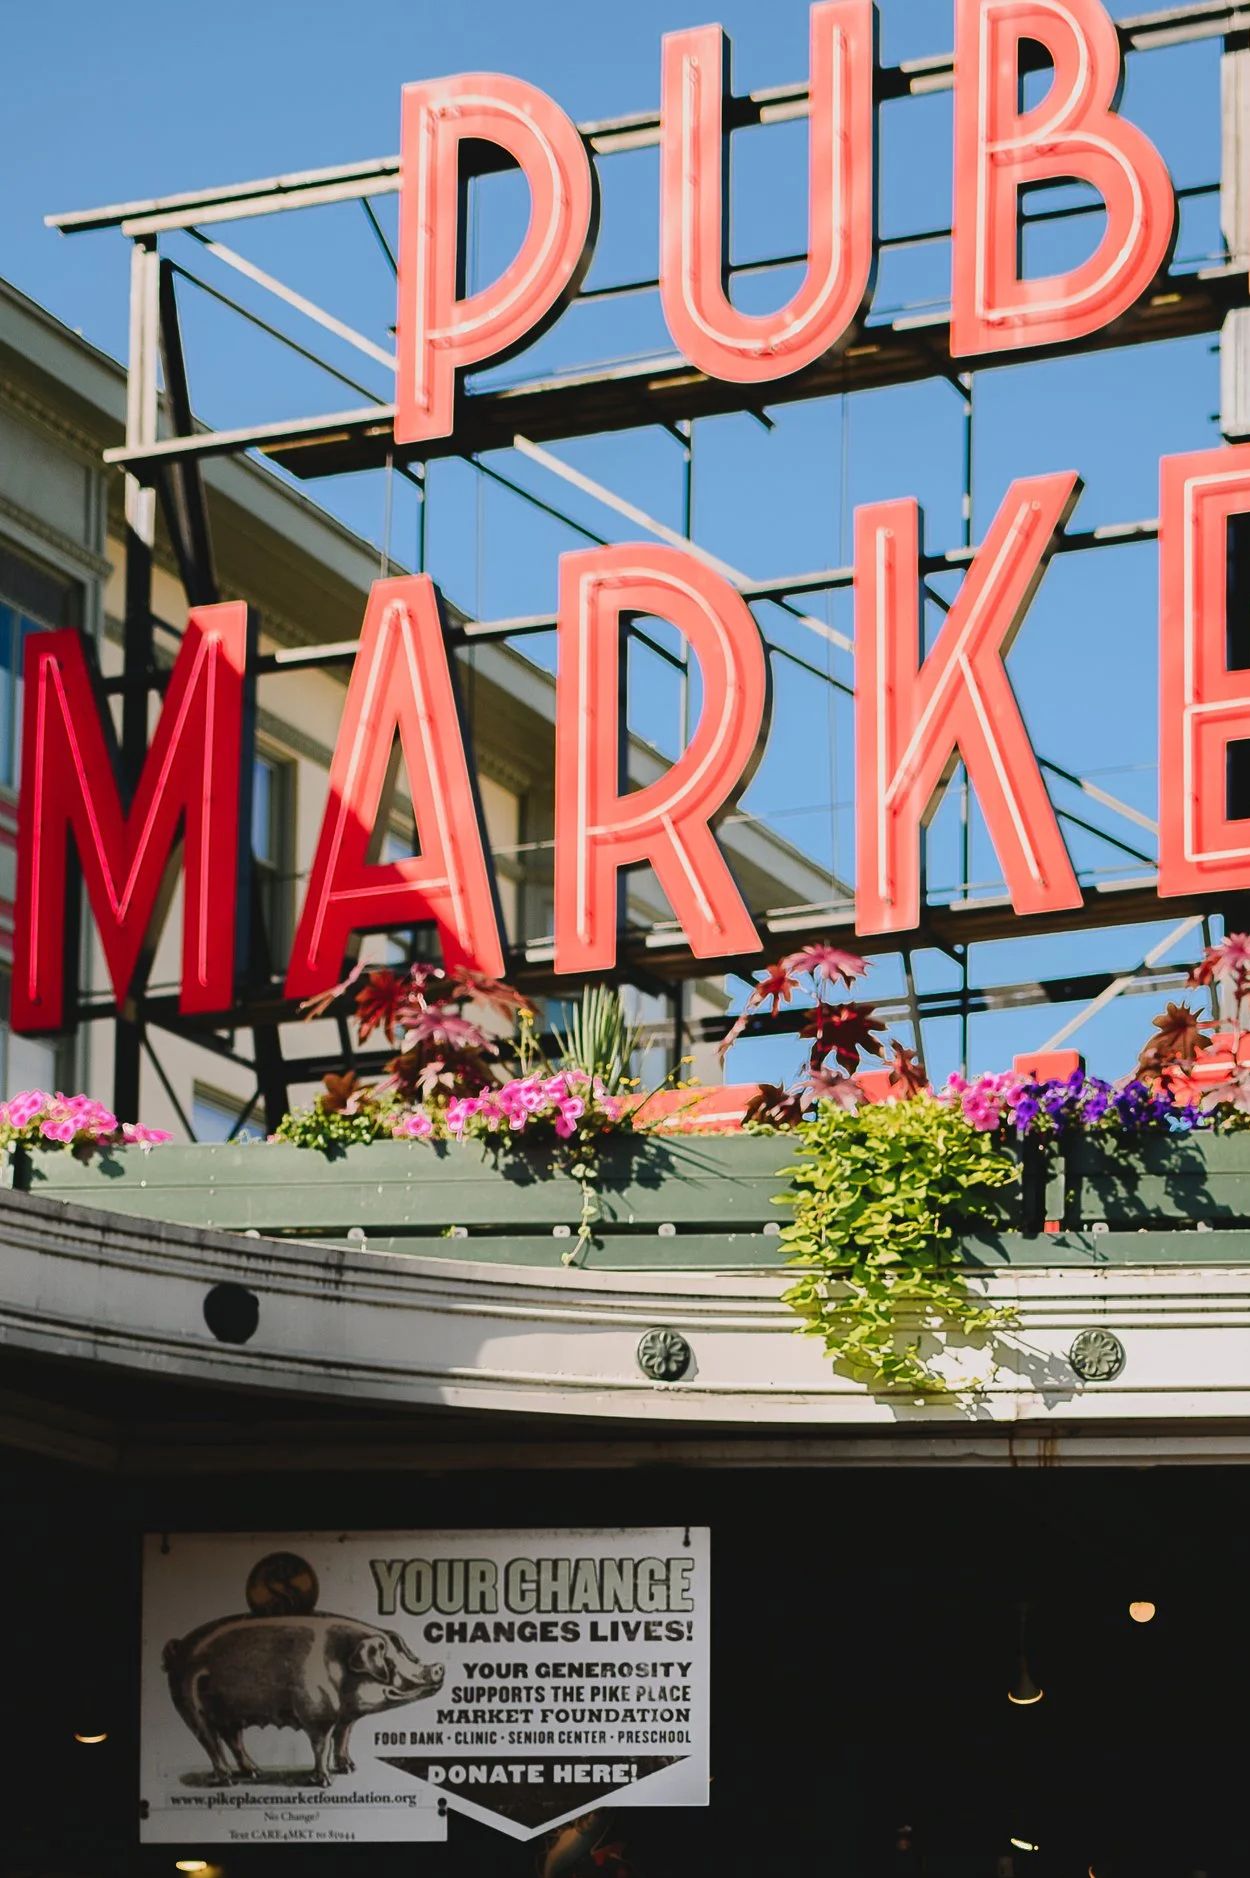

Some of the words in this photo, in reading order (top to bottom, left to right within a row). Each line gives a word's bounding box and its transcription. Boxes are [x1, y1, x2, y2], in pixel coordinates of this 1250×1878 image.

[370, 1557, 498, 1615] YOUR
[505, 1557, 694, 1615] CHANGE
[423, 1620, 580, 1643] CHANGES
[589, 1620, 693, 1642] LIVES!
[462, 1662, 529, 1679] YOUR
[534, 1661, 692, 1678] GENEROSITY
[451, 1686, 546, 1704] SUPPORTS
[550, 1686, 585, 1703] THE
[591, 1685, 630, 1702] PIKE
[635, 1685, 692, 1702] PLACE
[436, 1708, 535, 1725] MARKET
[540, 1707, 691, 1724] FOUNDATION
[374, 1731, 406, 1746] FOOD
[410, 1731, 443, 1745] BANK
[455, 1731, 497, 1745] CLINIC
[508, 1731, 555, 1745] SENIOR
[558, 1730, 607, 1744] CENTER
[618, 1730, 692, 1744] PRESCHOOL
[428, 1764, 544, 1784] DONATE
[553, 1764, 638, 1783] HERE!
[170, 1791, 417, 1809] www.pikeplacemarketfoundation.org
